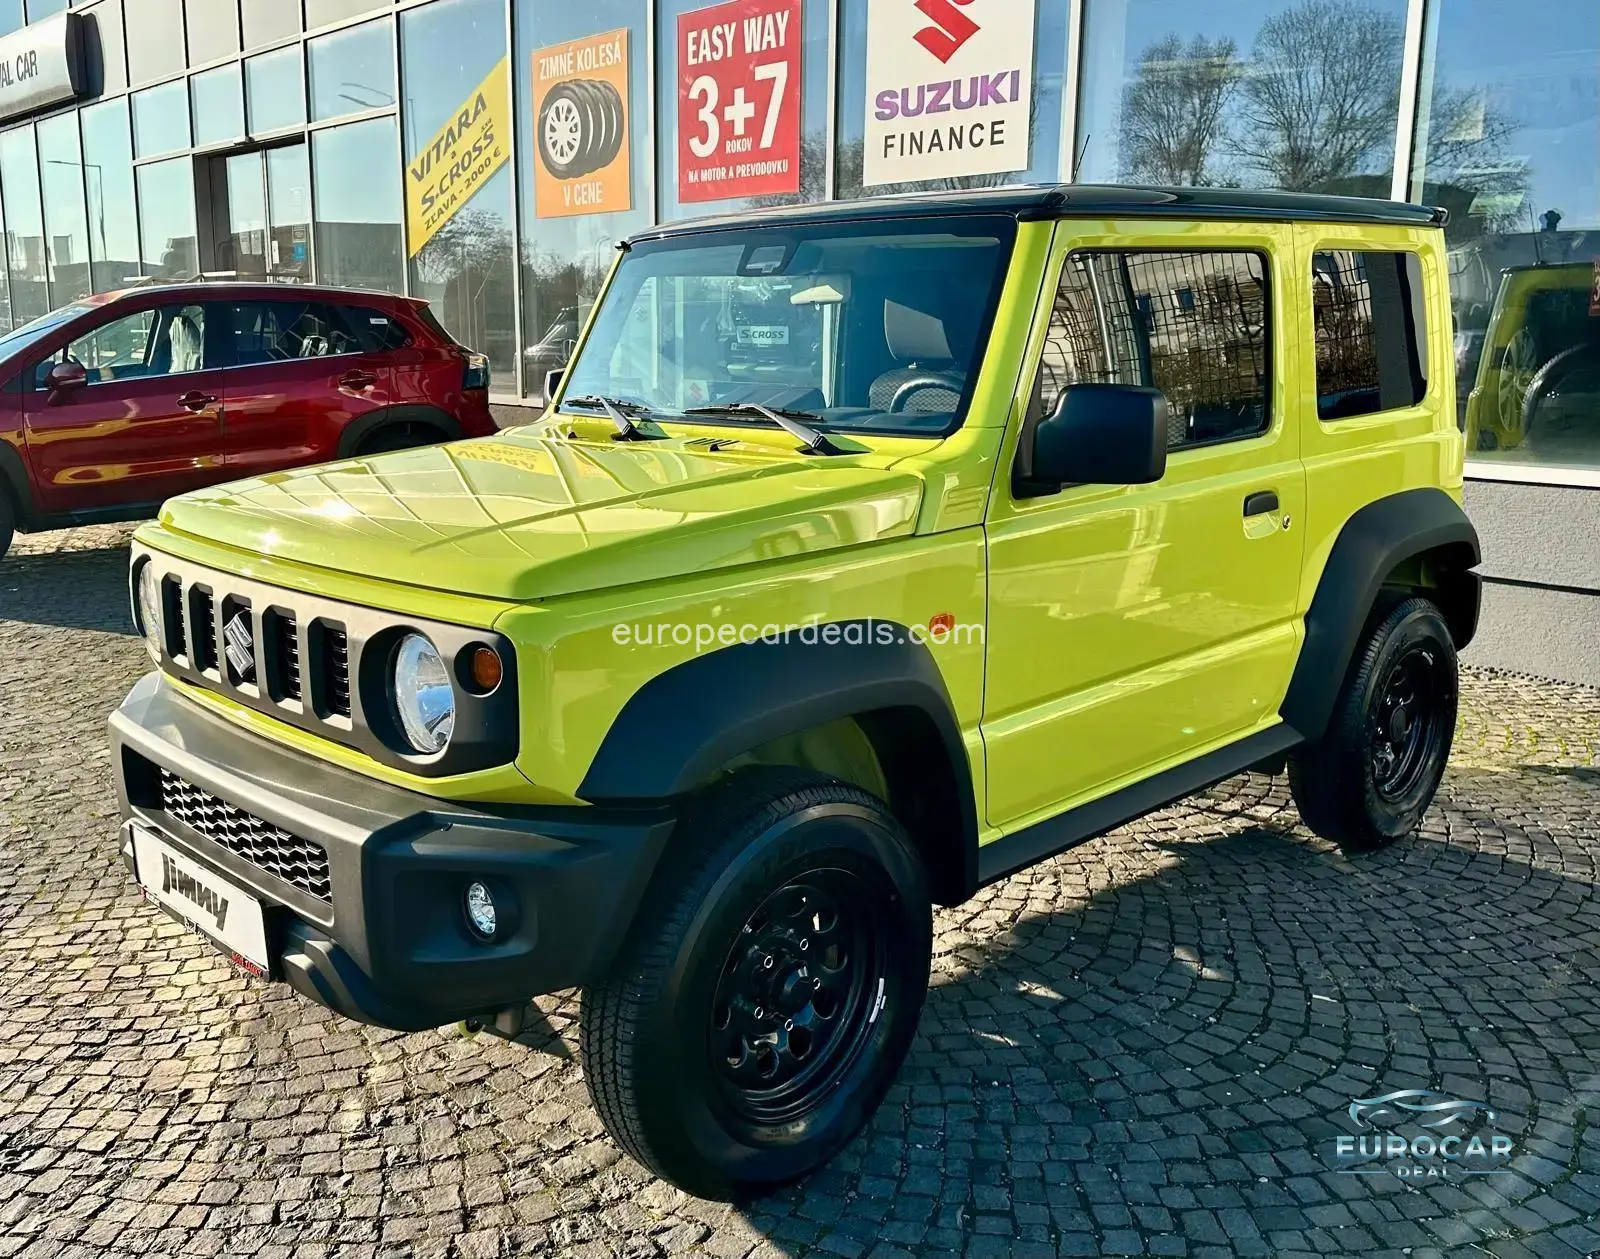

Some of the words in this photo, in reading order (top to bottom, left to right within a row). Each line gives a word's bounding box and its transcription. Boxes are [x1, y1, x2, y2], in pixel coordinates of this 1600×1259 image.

[539, 46, 574, 80] ZIMNÉ
[576, 35, 622, 73] KOLESÁ
[687, 22, 737, 66] EASY
[743, 9, 790, 54] WAY
[0, 60, 14, 88] AL
[16, 50, 38, 82] CAR
[688, 61, 788, 158] 3+7
[874, 69, 1020, 121] SUZUKI
[411, 92, 487, 182] VITARA
[725, 137, 753, 154] ROKOV
[883, 120, 1005, 158] FINANCE
[421, 124, 494, 217] S-CROSS
[464, 156, 491, 189] 2000
[493, 146, 501, 158] €
[688, 171, 700, 183] NA
[700, 166, 727, 182] MOTOR
[728, 167, 734, 179] A
[736, 159, 788, 177] PREVODOVKU
[563, 184, 572, 206] V
[574, 181, 603, 206] CENE
